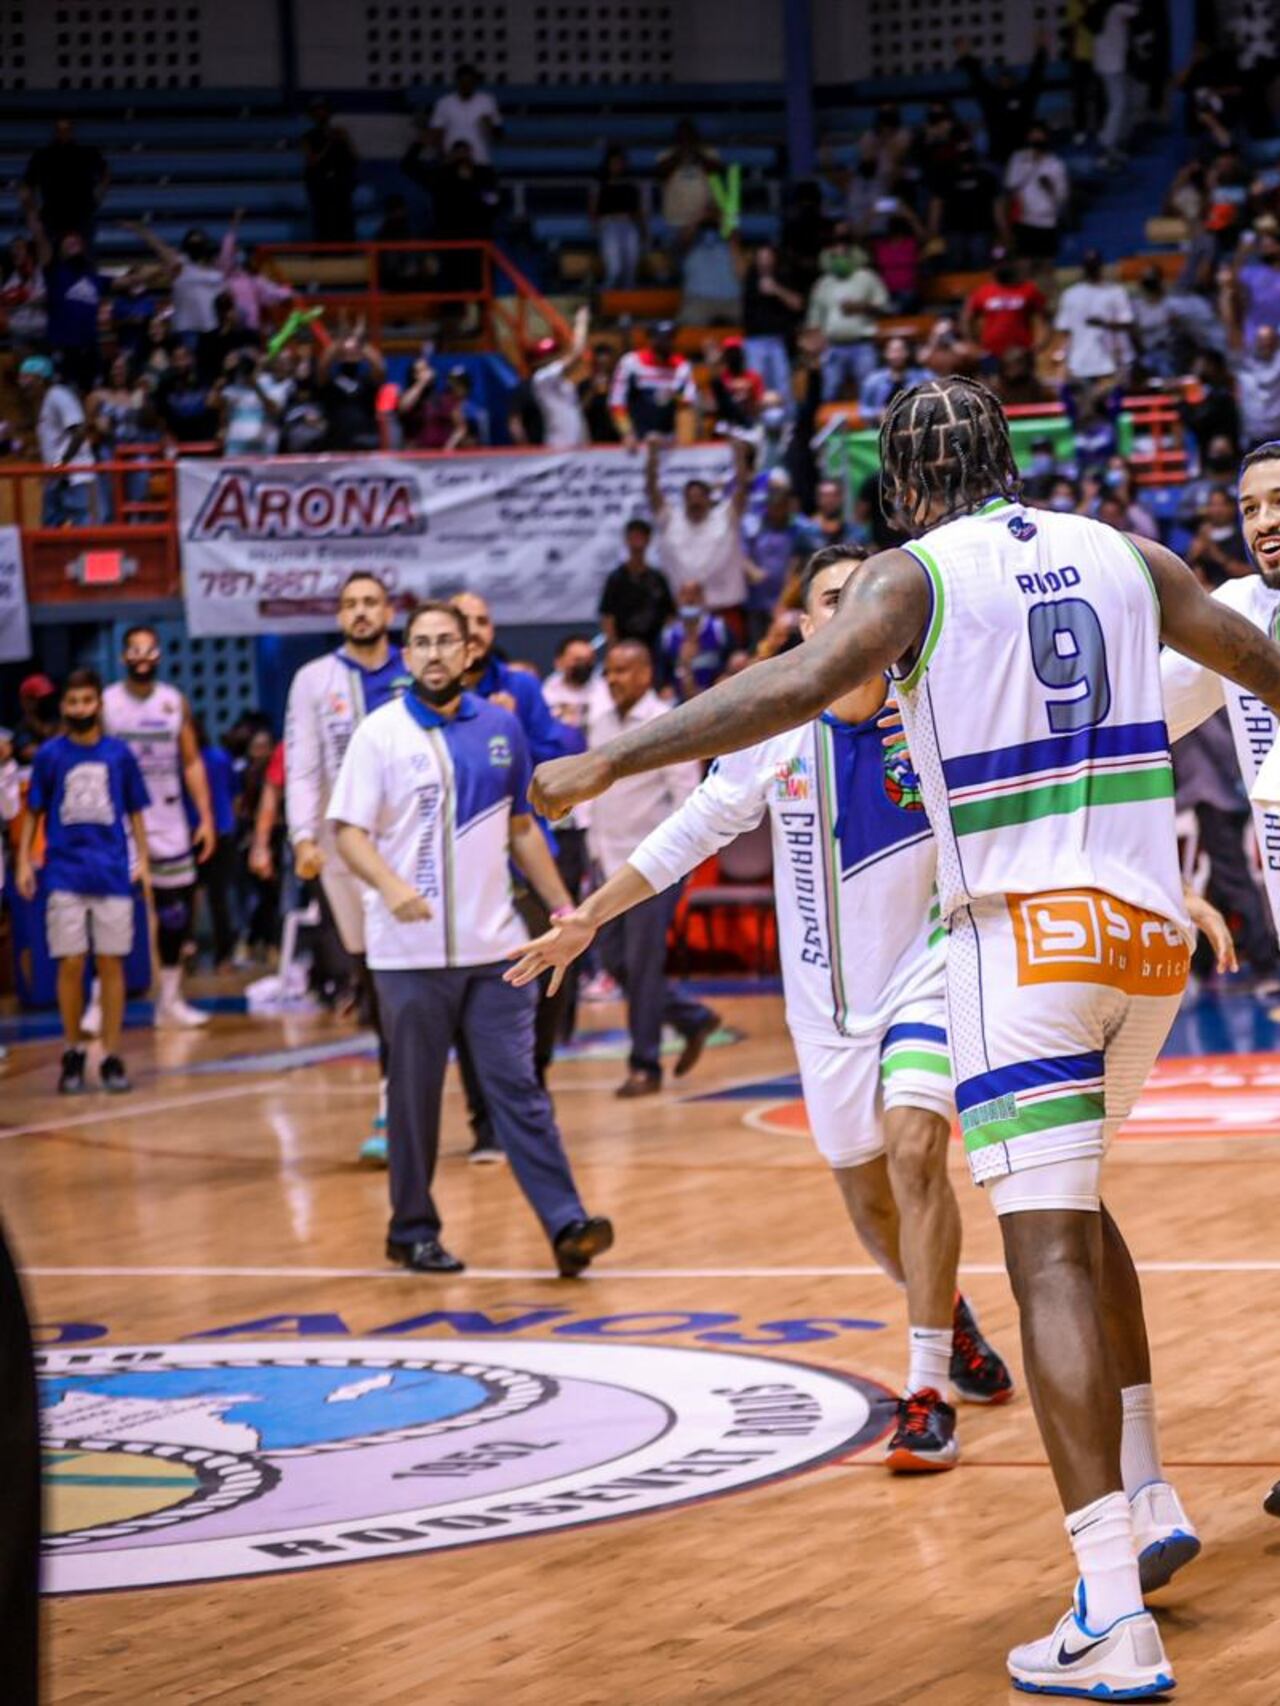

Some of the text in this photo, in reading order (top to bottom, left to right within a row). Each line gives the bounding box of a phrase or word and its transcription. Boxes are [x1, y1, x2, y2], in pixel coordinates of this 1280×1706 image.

[196, 471, 421, 537] ARONA
[1028, 597, 1112, 734] 9
[250, 1382, 824, 1559] ROOSEVELT ROADS
[392, 1440, 562, 1481] 1952
